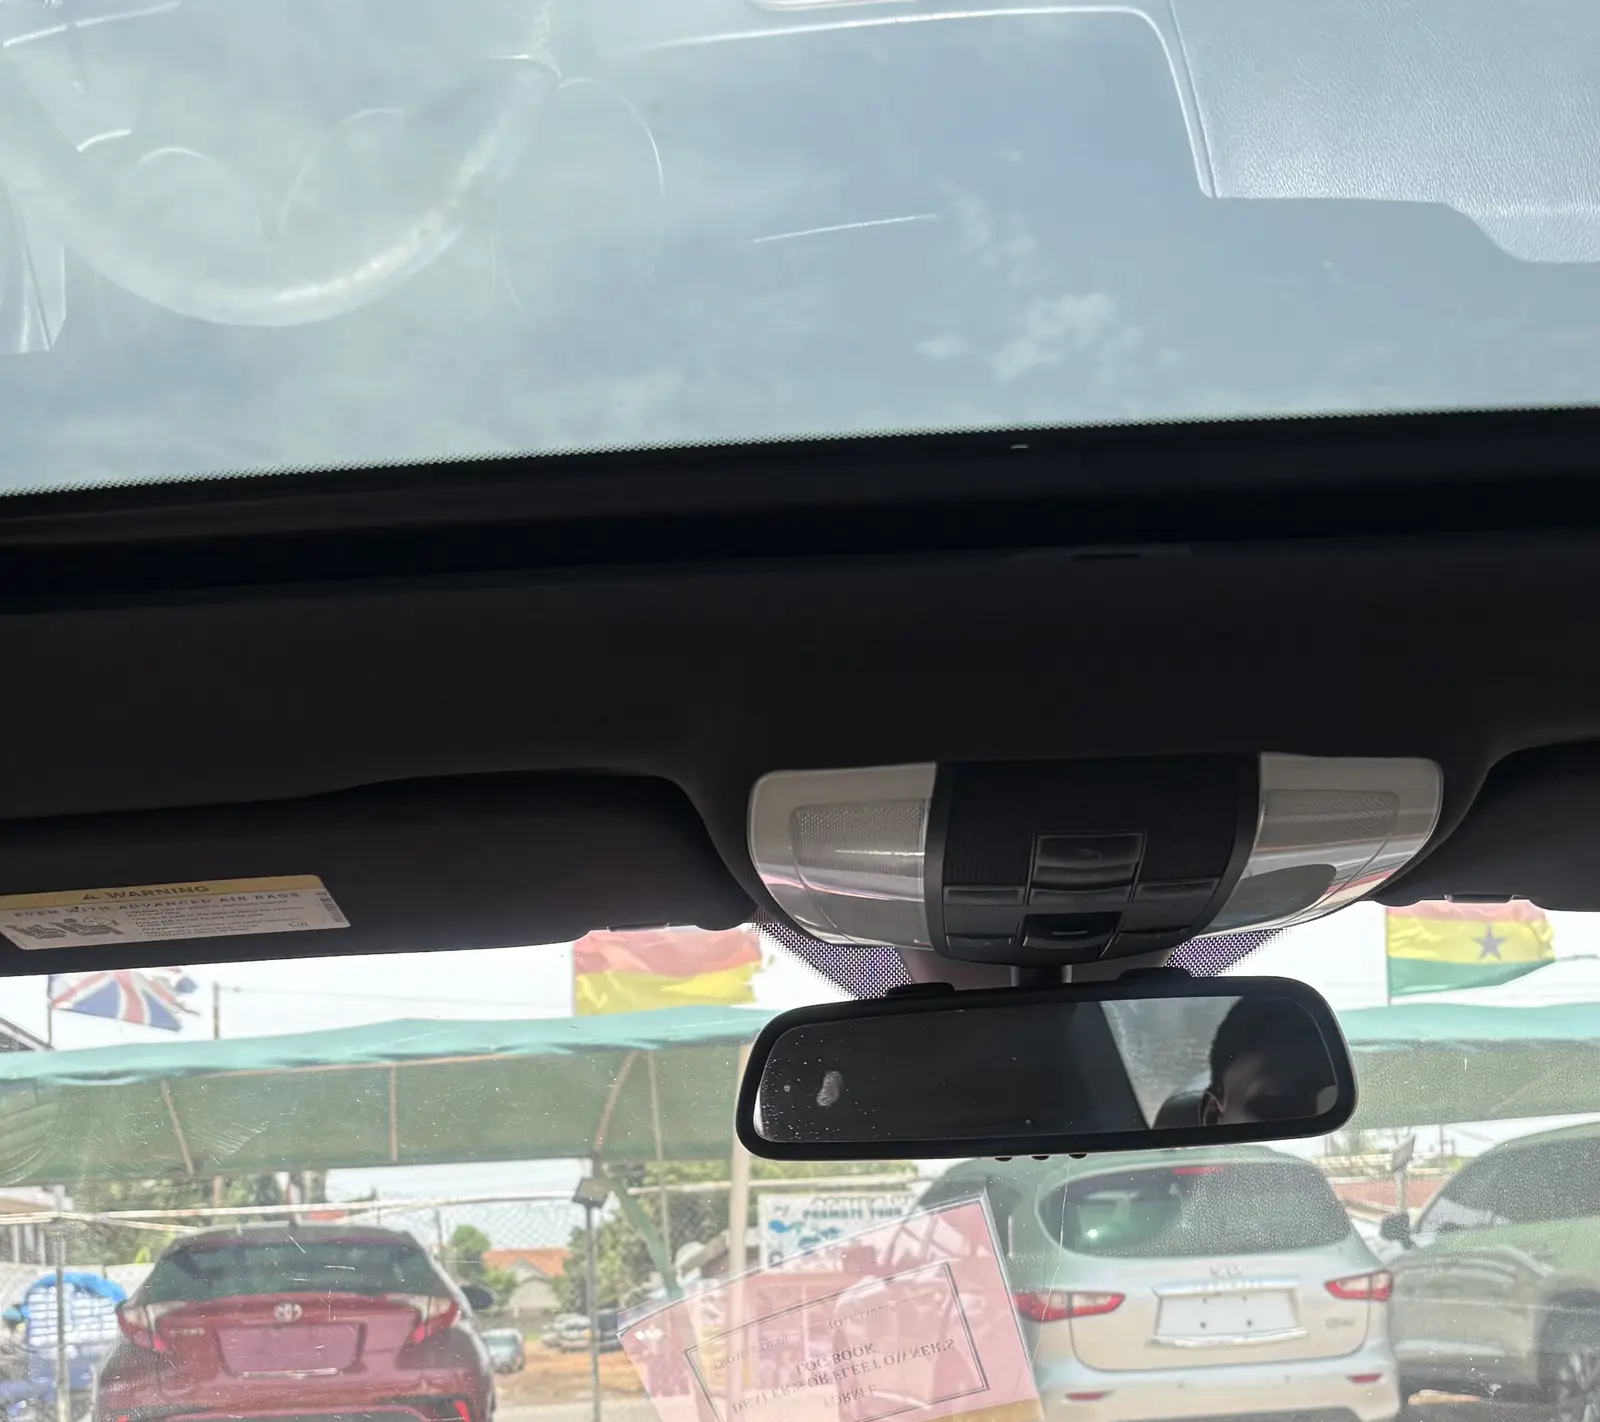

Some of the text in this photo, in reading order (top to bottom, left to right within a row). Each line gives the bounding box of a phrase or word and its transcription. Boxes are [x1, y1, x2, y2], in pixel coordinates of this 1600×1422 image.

[105, 885, 210, 900] WARNING
[13, 891, 301, 918] EVEN WITH ADVANCED AIR BAGS
